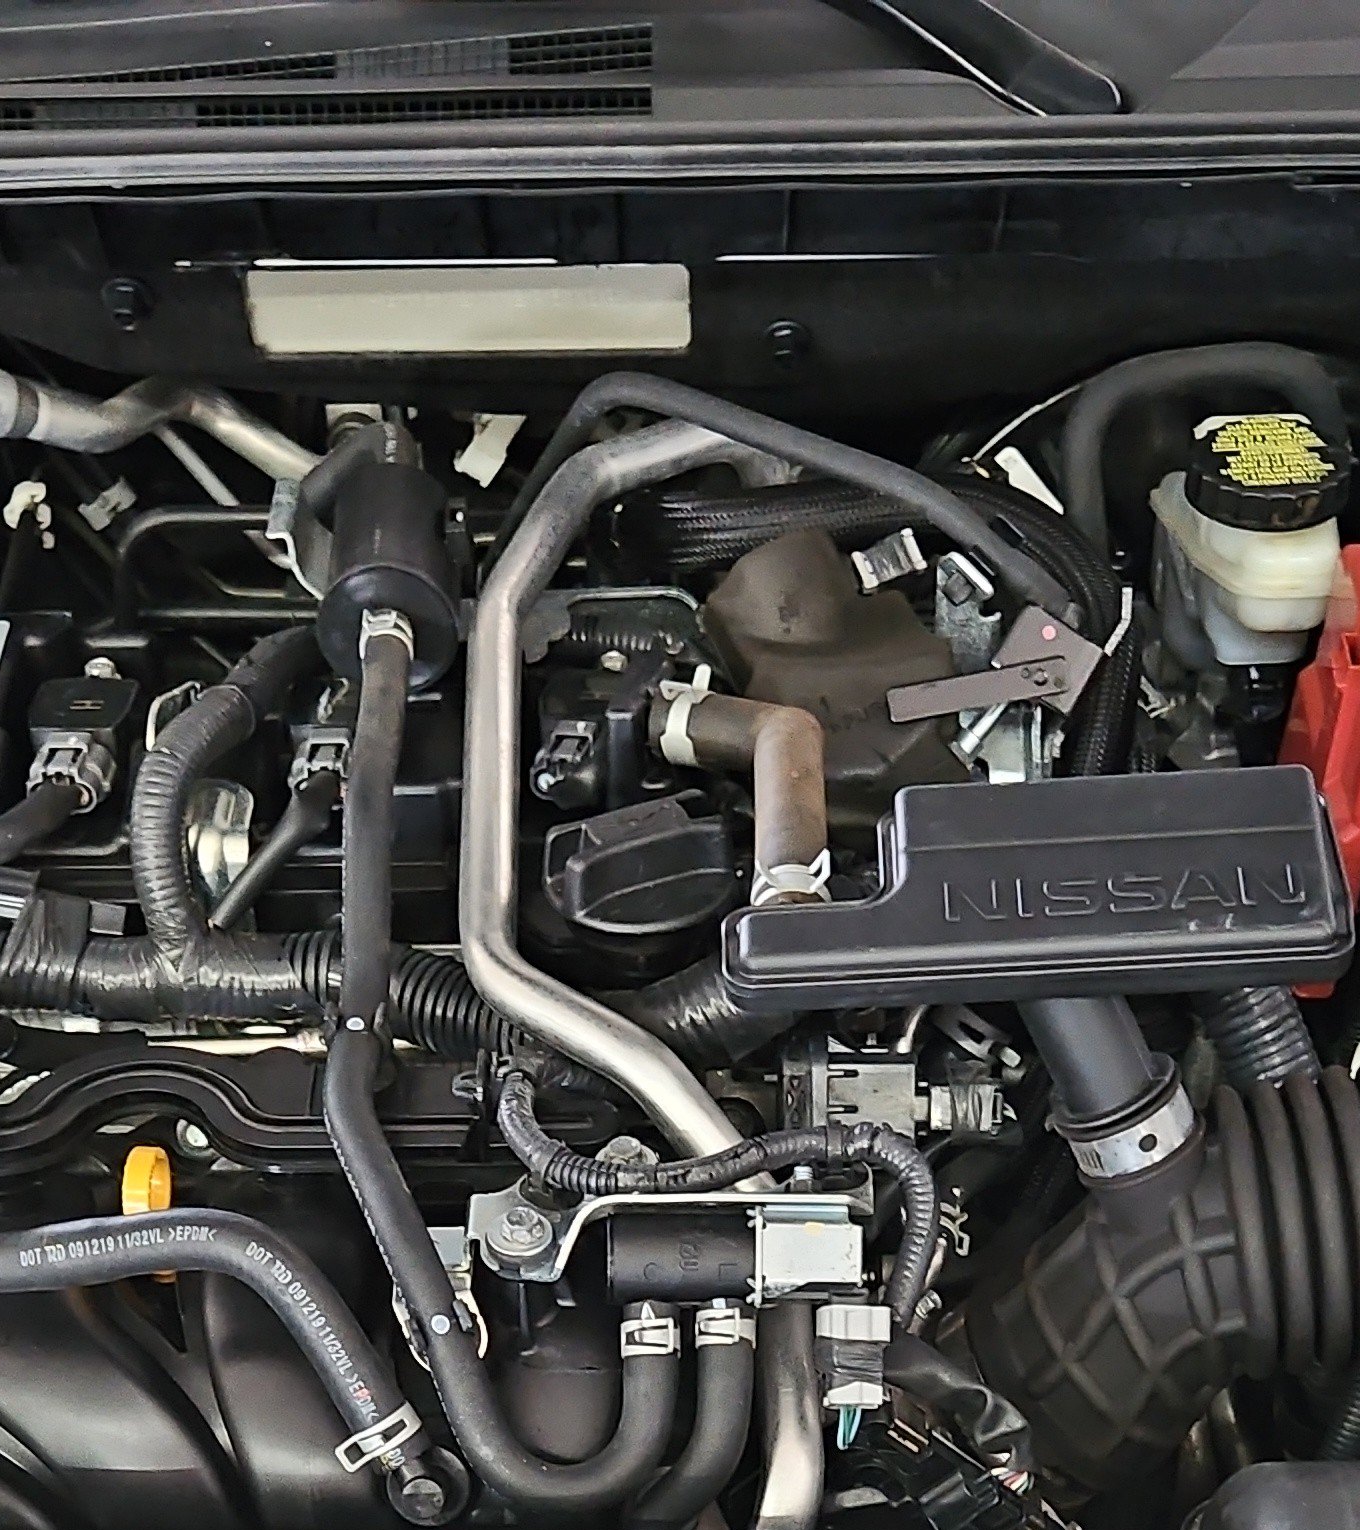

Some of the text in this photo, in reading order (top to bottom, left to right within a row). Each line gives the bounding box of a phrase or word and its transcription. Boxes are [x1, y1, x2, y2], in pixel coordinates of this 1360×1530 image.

[943, 864, 1307, 923] NISSAN
[67, 1236, 115, 1259] 091219
[245, 1241, 273, 1265] DOT
[288, 1281, 327, 1328] 091219
